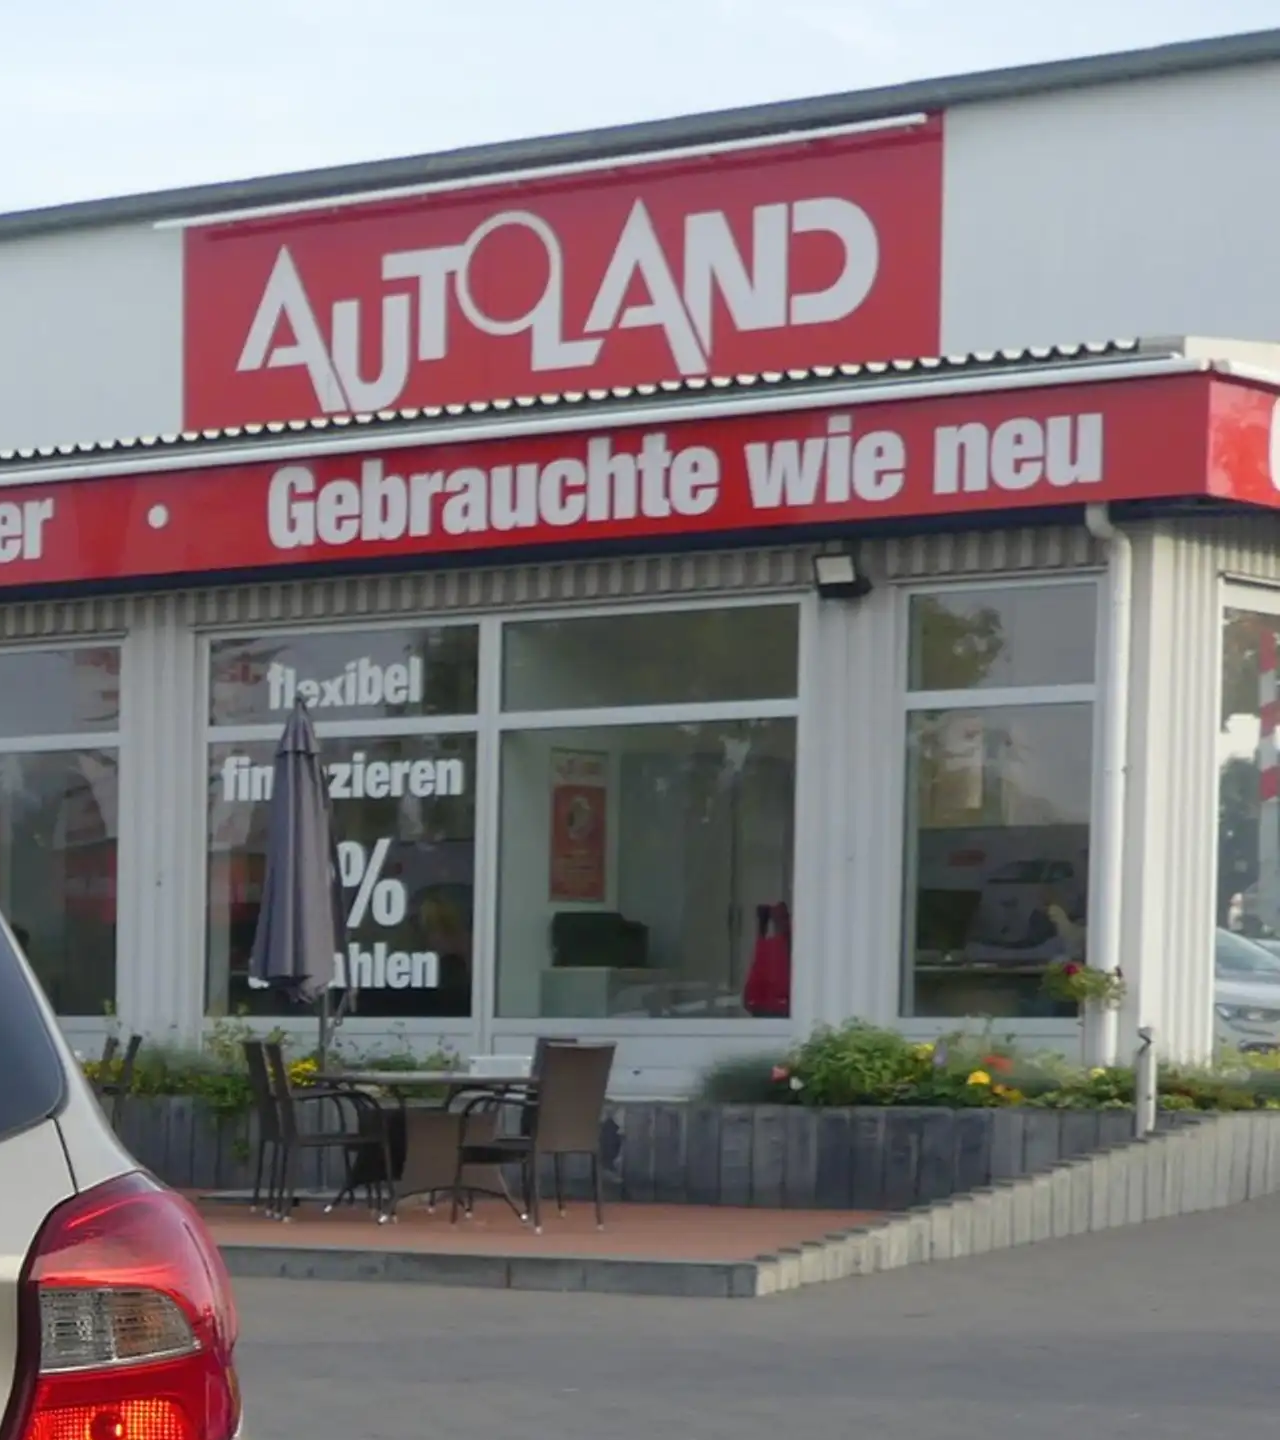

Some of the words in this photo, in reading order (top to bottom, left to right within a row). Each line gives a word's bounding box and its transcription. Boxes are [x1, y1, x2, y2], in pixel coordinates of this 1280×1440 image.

[267, 436, 721, 549] Gebrauchte
[745, 415, 907, 508] wie
[932, 412, 1104, 495] neu
[268, 656, 423, 709] flexibel
